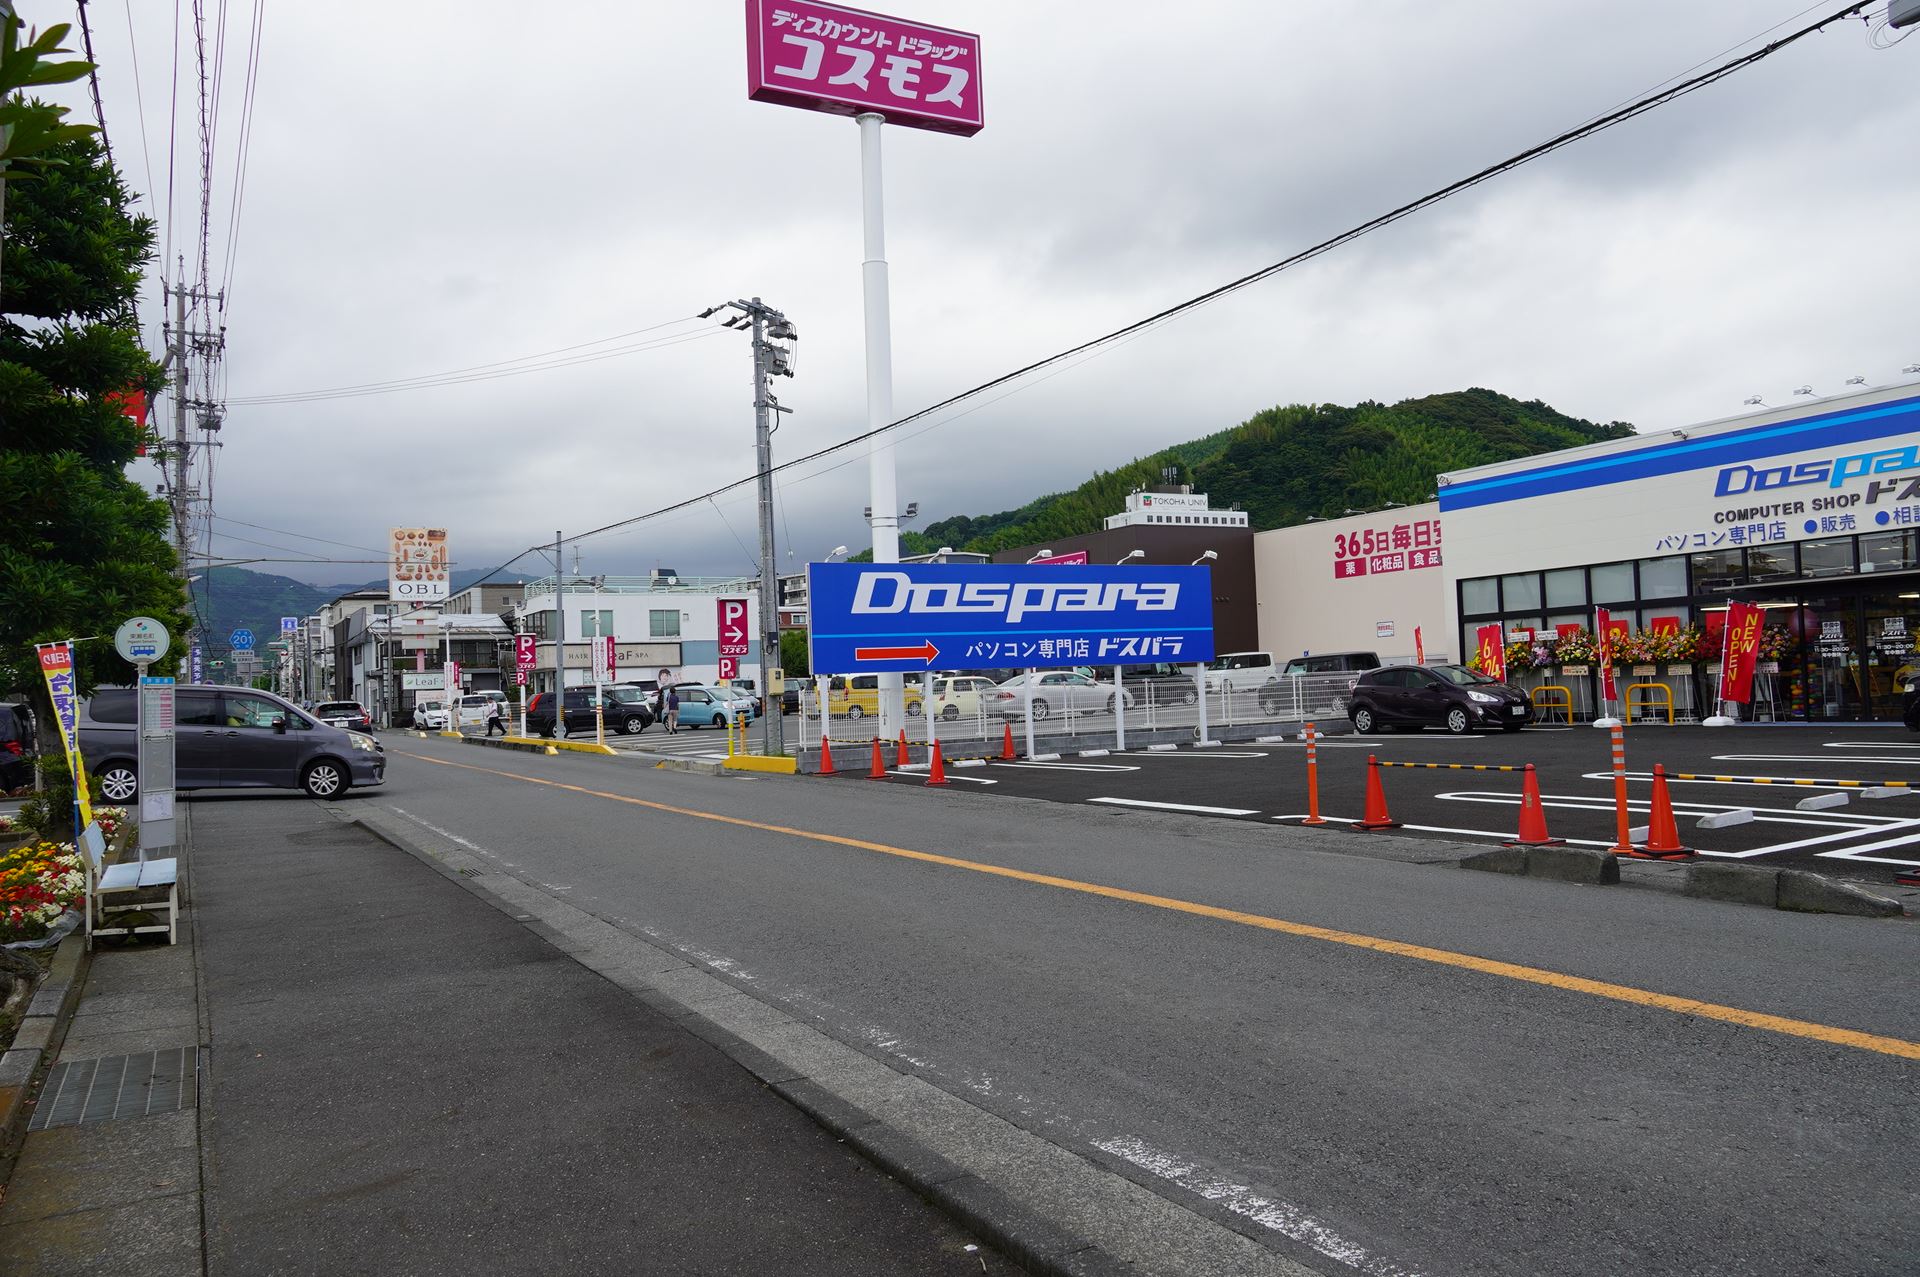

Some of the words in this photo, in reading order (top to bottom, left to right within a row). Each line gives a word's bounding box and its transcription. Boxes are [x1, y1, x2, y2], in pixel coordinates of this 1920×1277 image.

[771, 9, 892, 49] ディスカウント
[898, 35, 968, 61] ドラッグ
[773, 34, 970, 109] コスモス
[1153, 497, 1186, 506] TOKOHA
[1713, 501, 1804, 524] COMPUTER
[1811, 493, 1861, 512] SHOP
[1655, 519, 1787, 551] パソコン専門店
[1820, 513, 1857, 533] 販売
[1345, 561, 1356, 575] 薬
[1371, 555, 1403, 572] 化粧品
[1413, 550, 1440, 567] 食品
[398, 584, 444, 595] OBL
[850, 571, 1181, 623] Dospara
[725, 602, 744, 626] P
[233, 635, 253, 645] 201
[521, 636, 533, 651] P
[1740, 613, 1759, 654] NEW
[568, 652, 589, 660] HAIR
[965, 638, 1090, 659] パソコン専門店
[1097, 636, 1184, 657] ドスパラ
[720, 660, 732, 677] P
[1727, 627, 1742, 696] OPEN!
